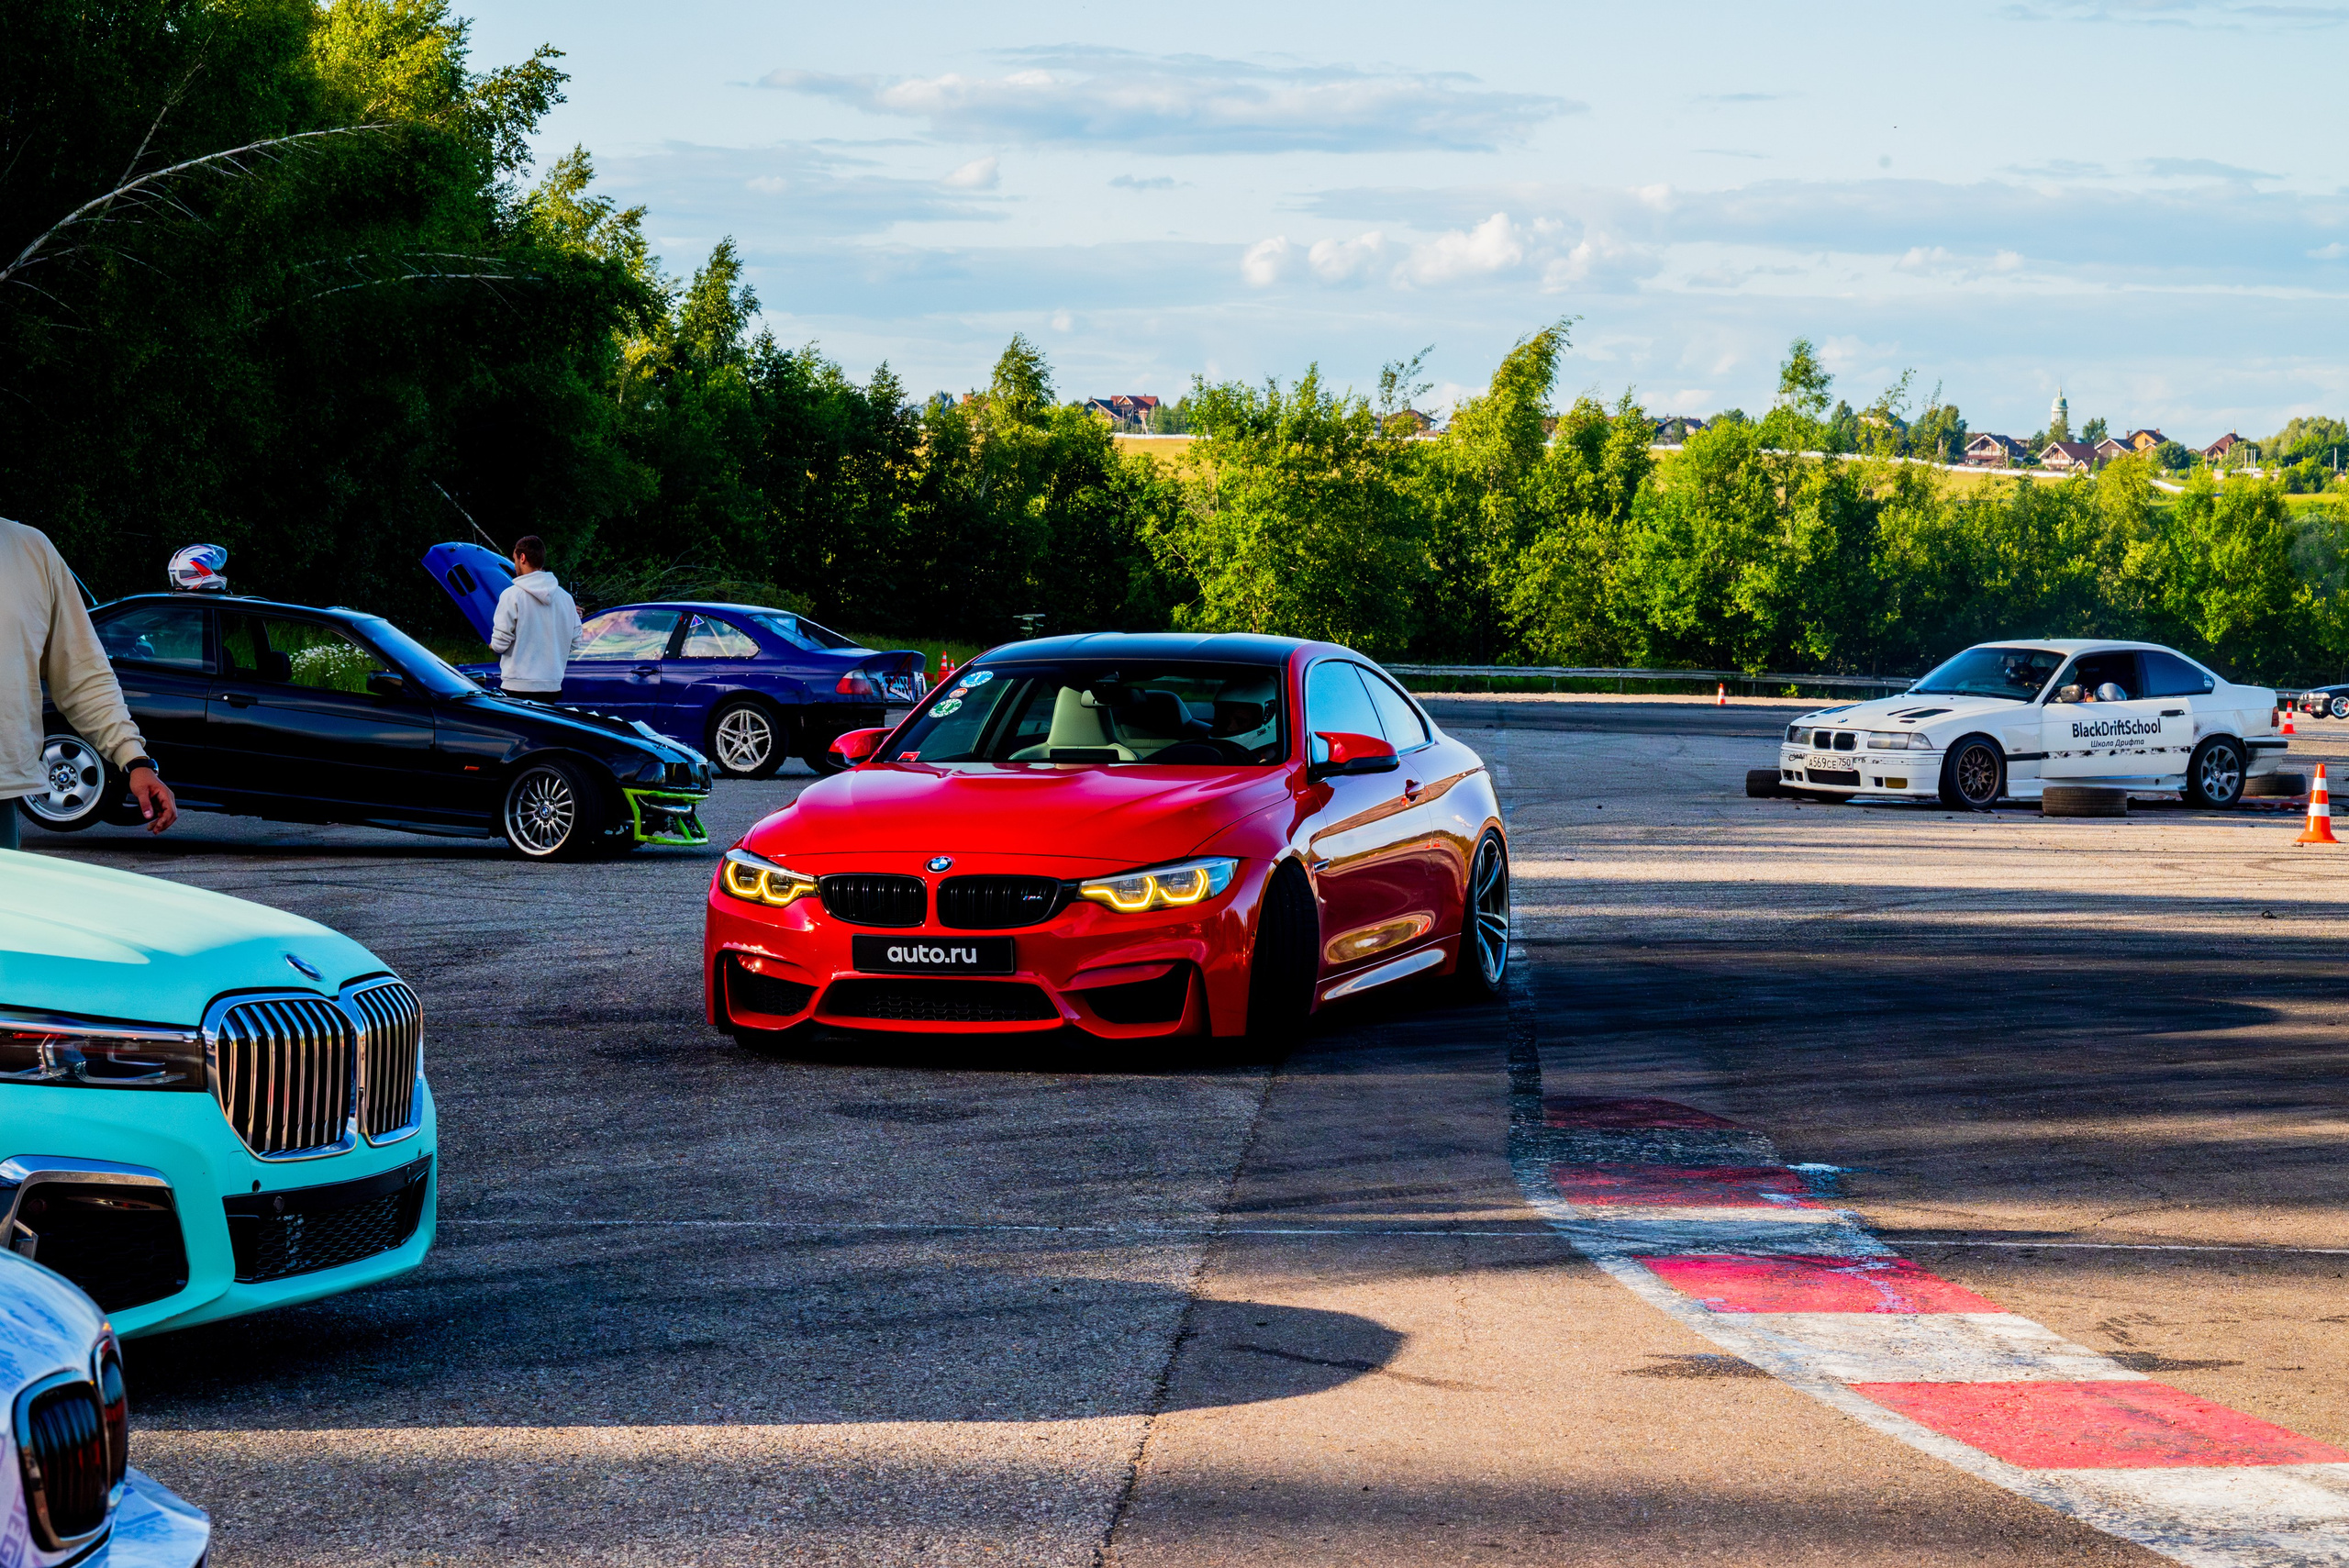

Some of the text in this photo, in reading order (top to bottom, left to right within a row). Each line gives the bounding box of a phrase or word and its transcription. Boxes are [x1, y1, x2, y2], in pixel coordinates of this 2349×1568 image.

[2072, 717, 2161, 738] BlackDriftSchool
[2115, 738, 2144, 748] Дрифта
[1838, 758, 1851, 766] 750
[887, 944, 976, 964] auto.ru
